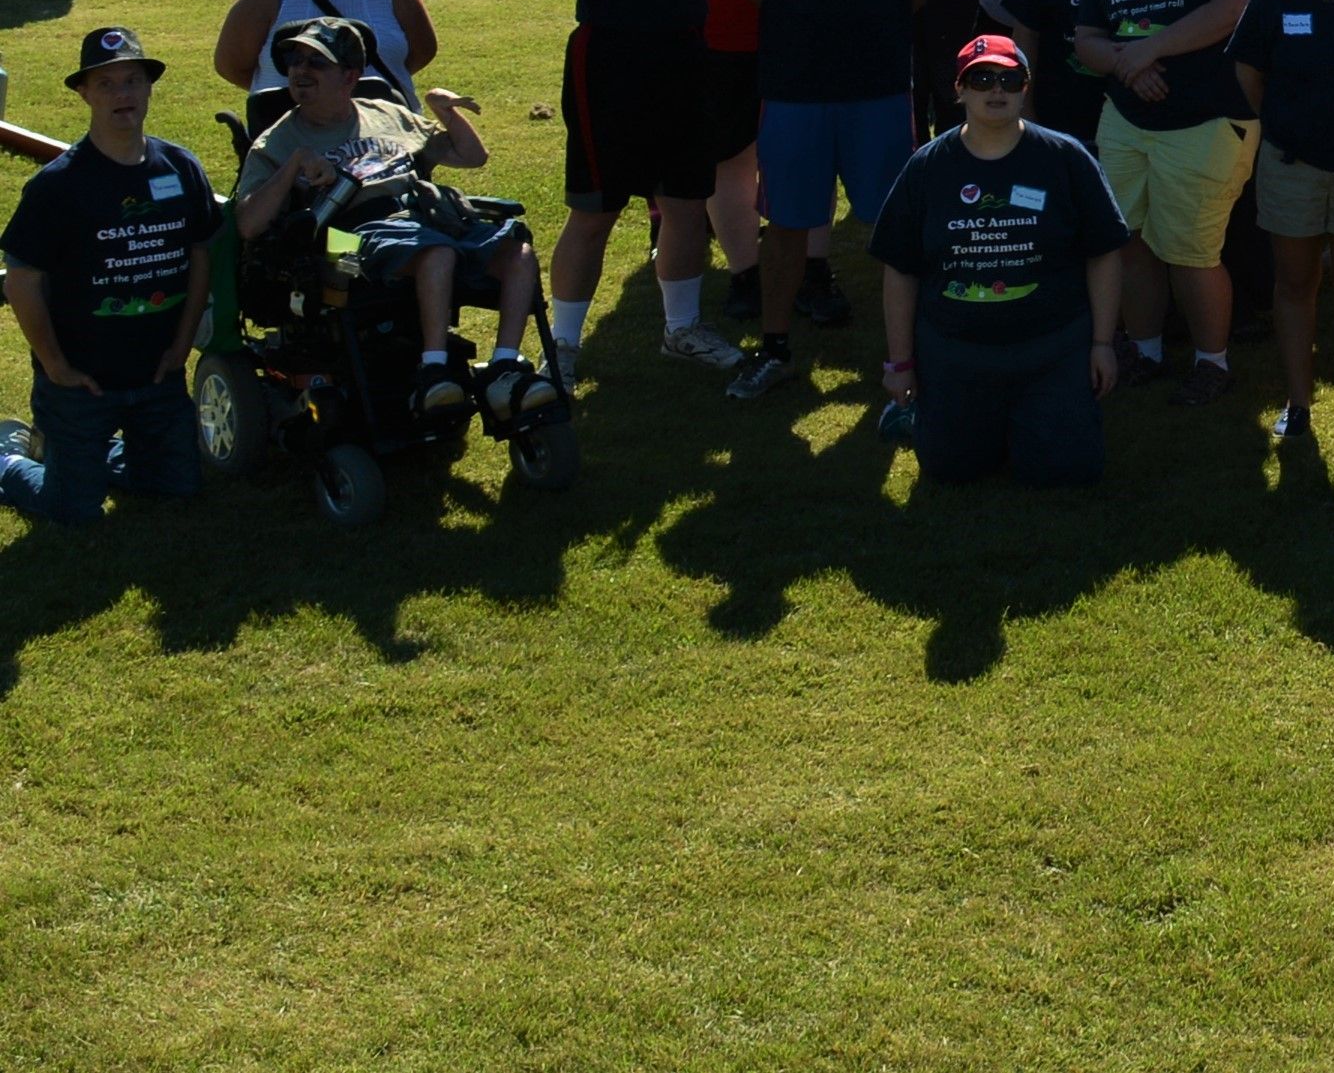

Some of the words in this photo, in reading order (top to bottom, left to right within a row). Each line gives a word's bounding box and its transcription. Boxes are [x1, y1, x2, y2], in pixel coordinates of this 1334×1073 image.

[96, 225, 136, 240] CSAC
[138, 217, 186, 236] Annual
[946, 216, 986, 231] CSAC
[988, 215, 1038, 229] Annual
[970, 230, 1008, 242] Bocce
[128, 238, 165, 252] Bocce
[951, 242, 1035, 256] Tournament
[104, 248, 184, 268] Tournament
[960, 258, 975, 269] the
[976, 258, 998, 271] good
[1000, 256, 1025, 268] times
[92, 276, 110, 286] Let
[113, 274, 130, 284] the
[132, 270, 153, 284] good
